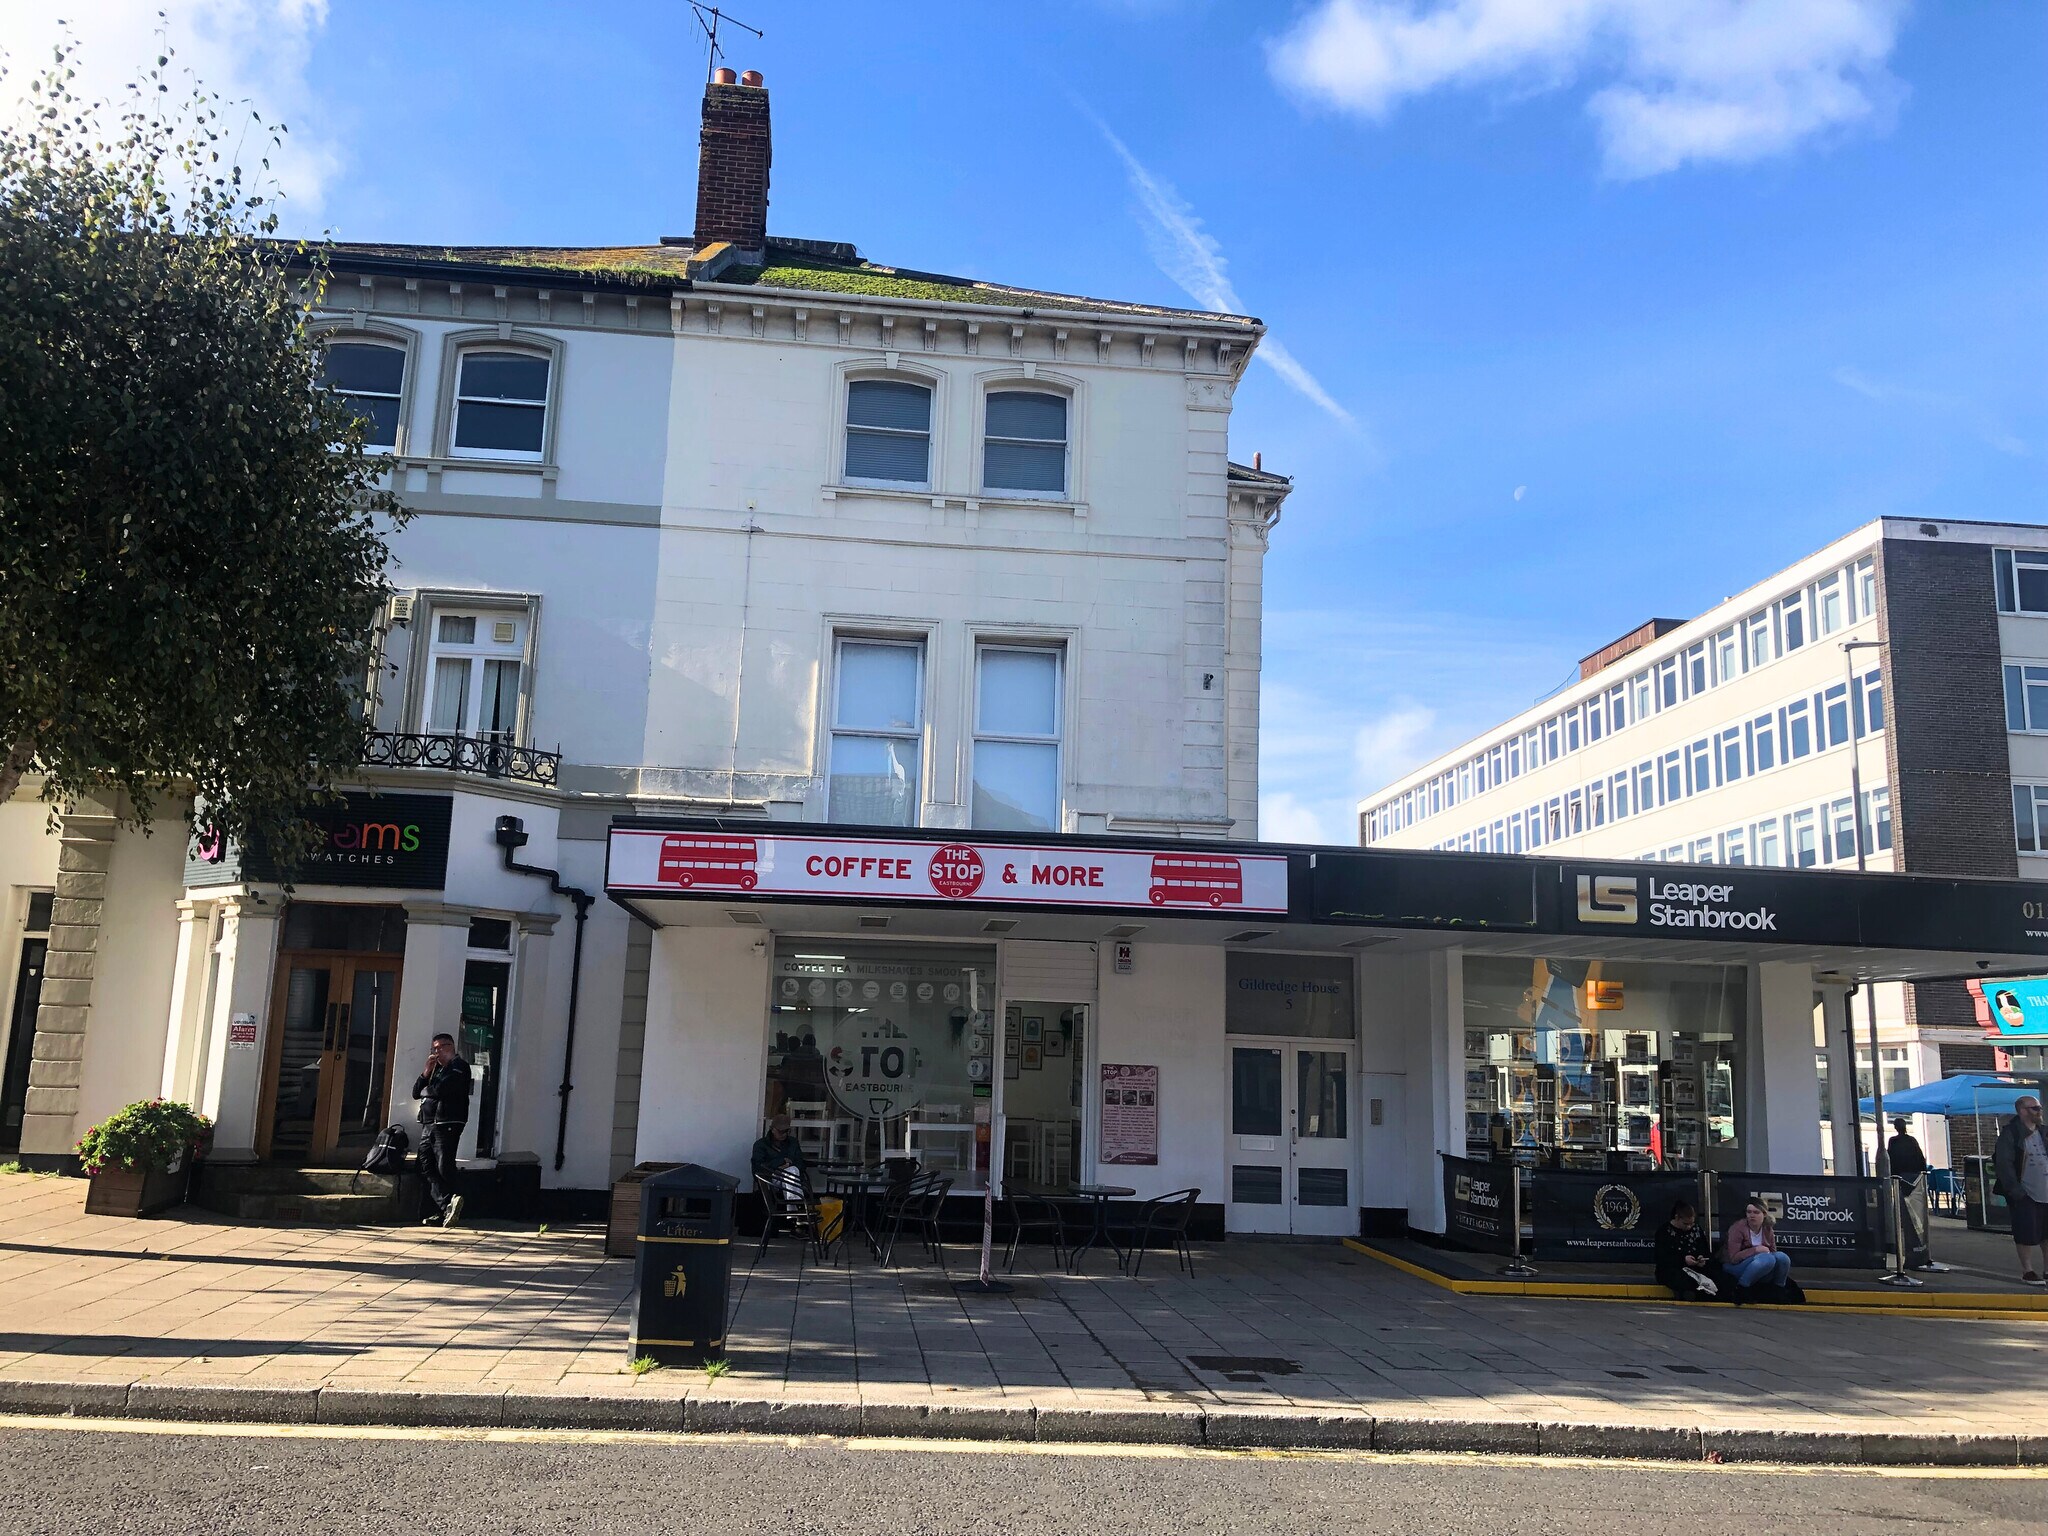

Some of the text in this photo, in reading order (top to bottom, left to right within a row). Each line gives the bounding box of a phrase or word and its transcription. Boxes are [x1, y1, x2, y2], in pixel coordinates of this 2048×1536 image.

[332, 822, 420, 852] ams
[944, 848, 971, 861] THE
[805, 855, 1104, 887] COFFEE & MORE
[930, 862, 983, 880] STOP
[1649, 877, 1734, 906] Leaper
[1649, 903, 1777, 931] Stanbrook
[2022, 901, 2048, 919] 01
[784, 962, 986, 978] COFFEE TEA MILKSHAKES SMOOTS
[1238, 978, 1340, 995] Gildredge House
[1285, 998, 1293, 1010] 5
[1470, 1177, 1491, 1193] Leaper
[1604, 1201, 1630, 1213] 1964
[1785, 1192, 1831, 1208] Leaper
[1786, 1207, 1854, 1222] Stanbrook
[666, 1225, 699, 1237] Litter
[1774, 1235, 1847, 1245] TATE AGENTS
